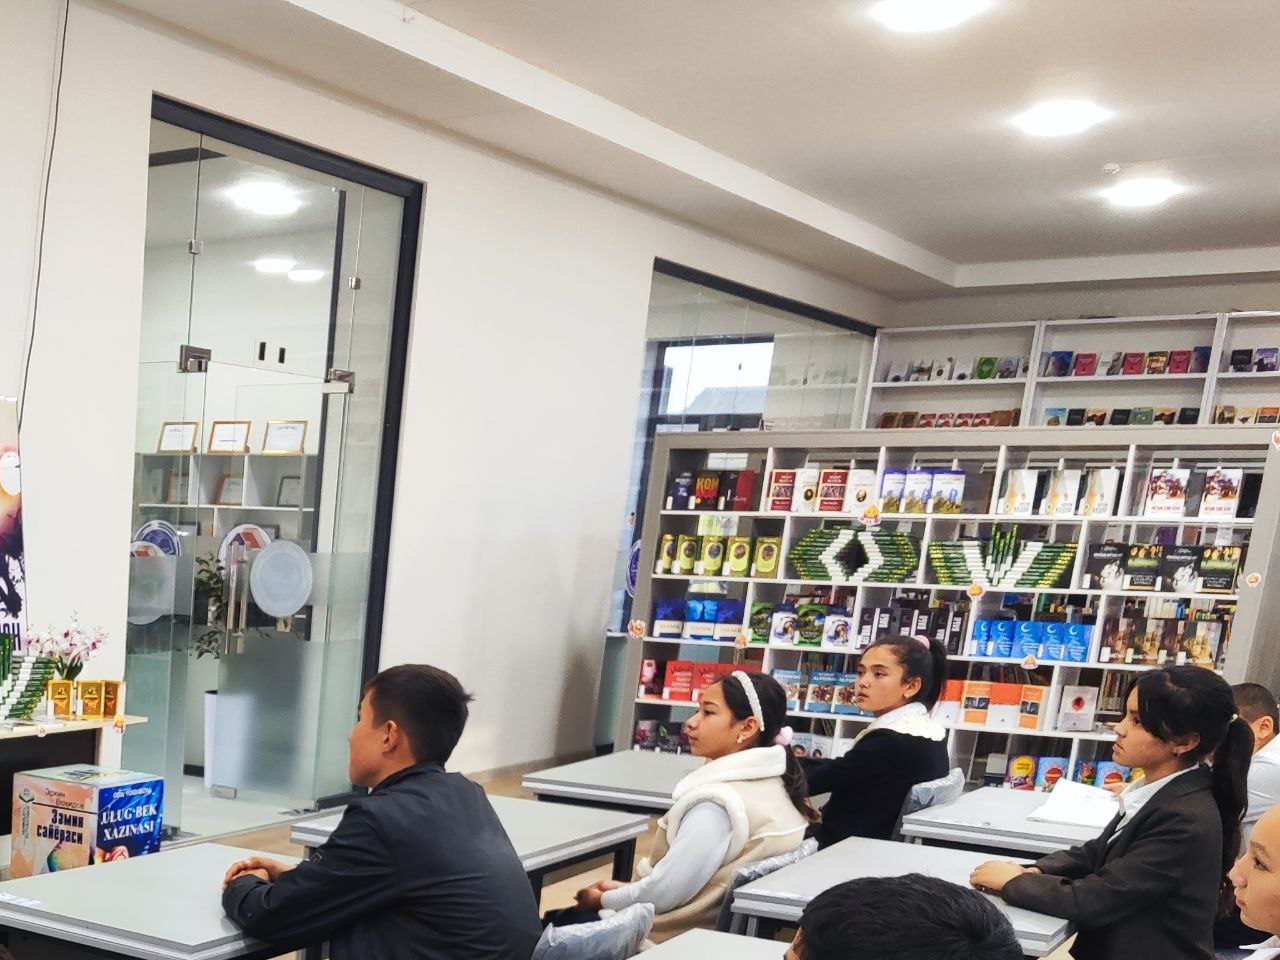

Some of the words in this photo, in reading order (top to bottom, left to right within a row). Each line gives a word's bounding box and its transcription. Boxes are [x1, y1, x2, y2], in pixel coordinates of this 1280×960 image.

[51, 809, 84, 829] Замин
[36, 824, 83, 846] сайёраси
[103, 820, 154, 842] XAZINASI
